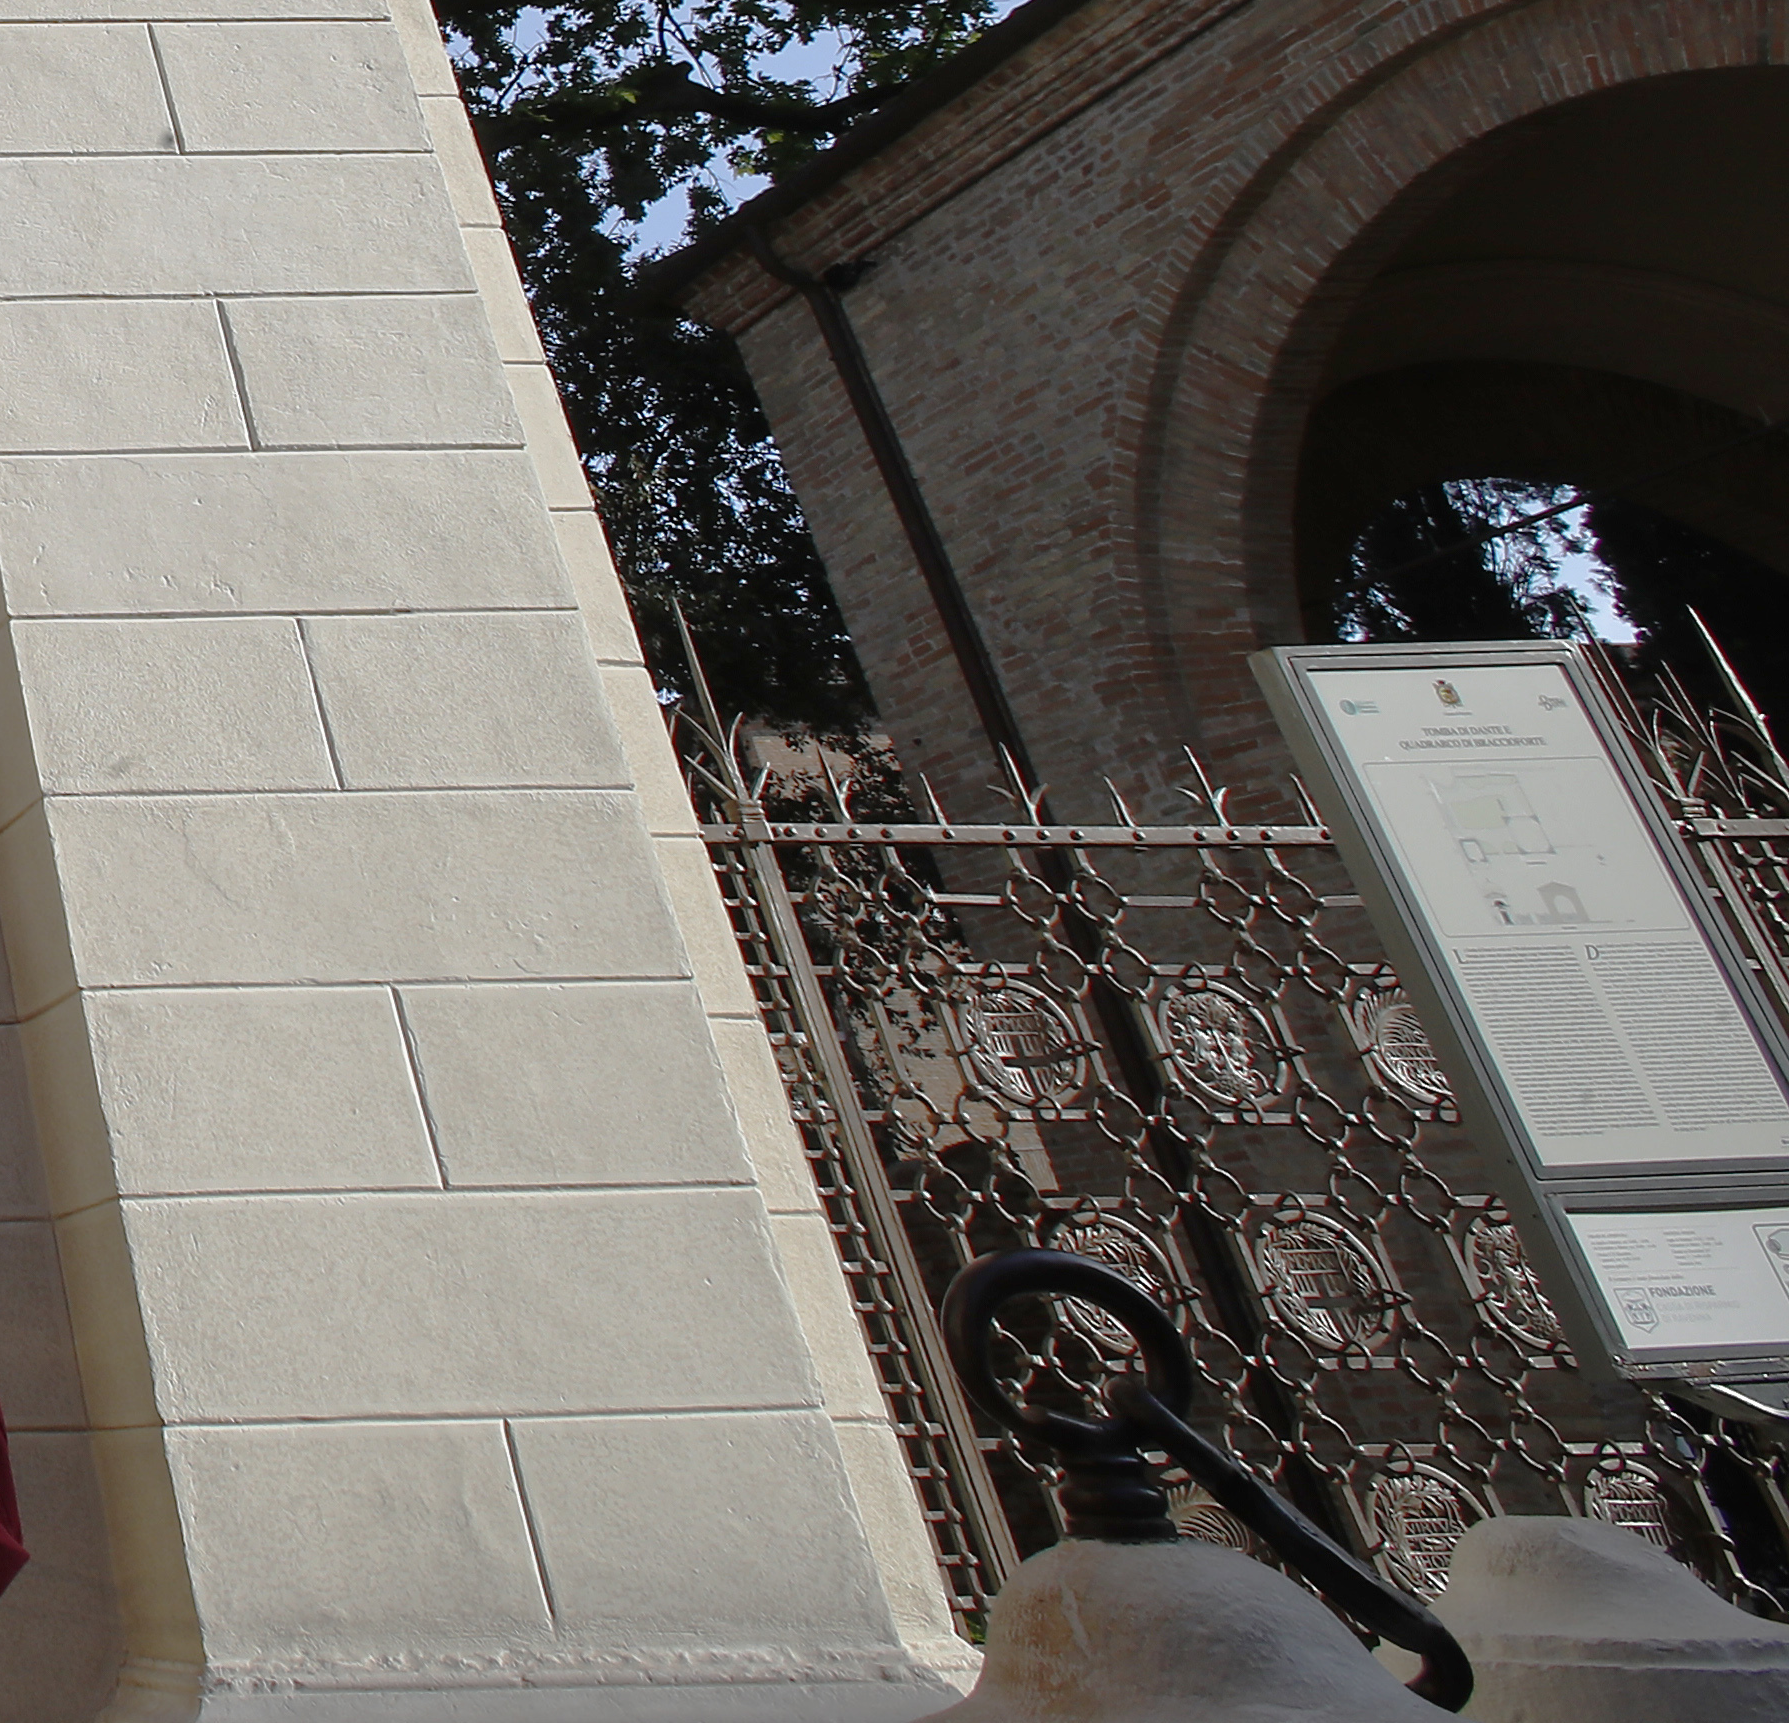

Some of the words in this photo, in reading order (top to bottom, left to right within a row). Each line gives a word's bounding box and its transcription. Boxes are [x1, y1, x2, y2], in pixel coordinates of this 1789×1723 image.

[1421, 727, 1457, 737] TOMBA
[1458, 727, 1469, 736] DI
[1470, 726, 1503, 736] DANTE
[1648, 1284, 1716, 1298] FONDAZIONE
